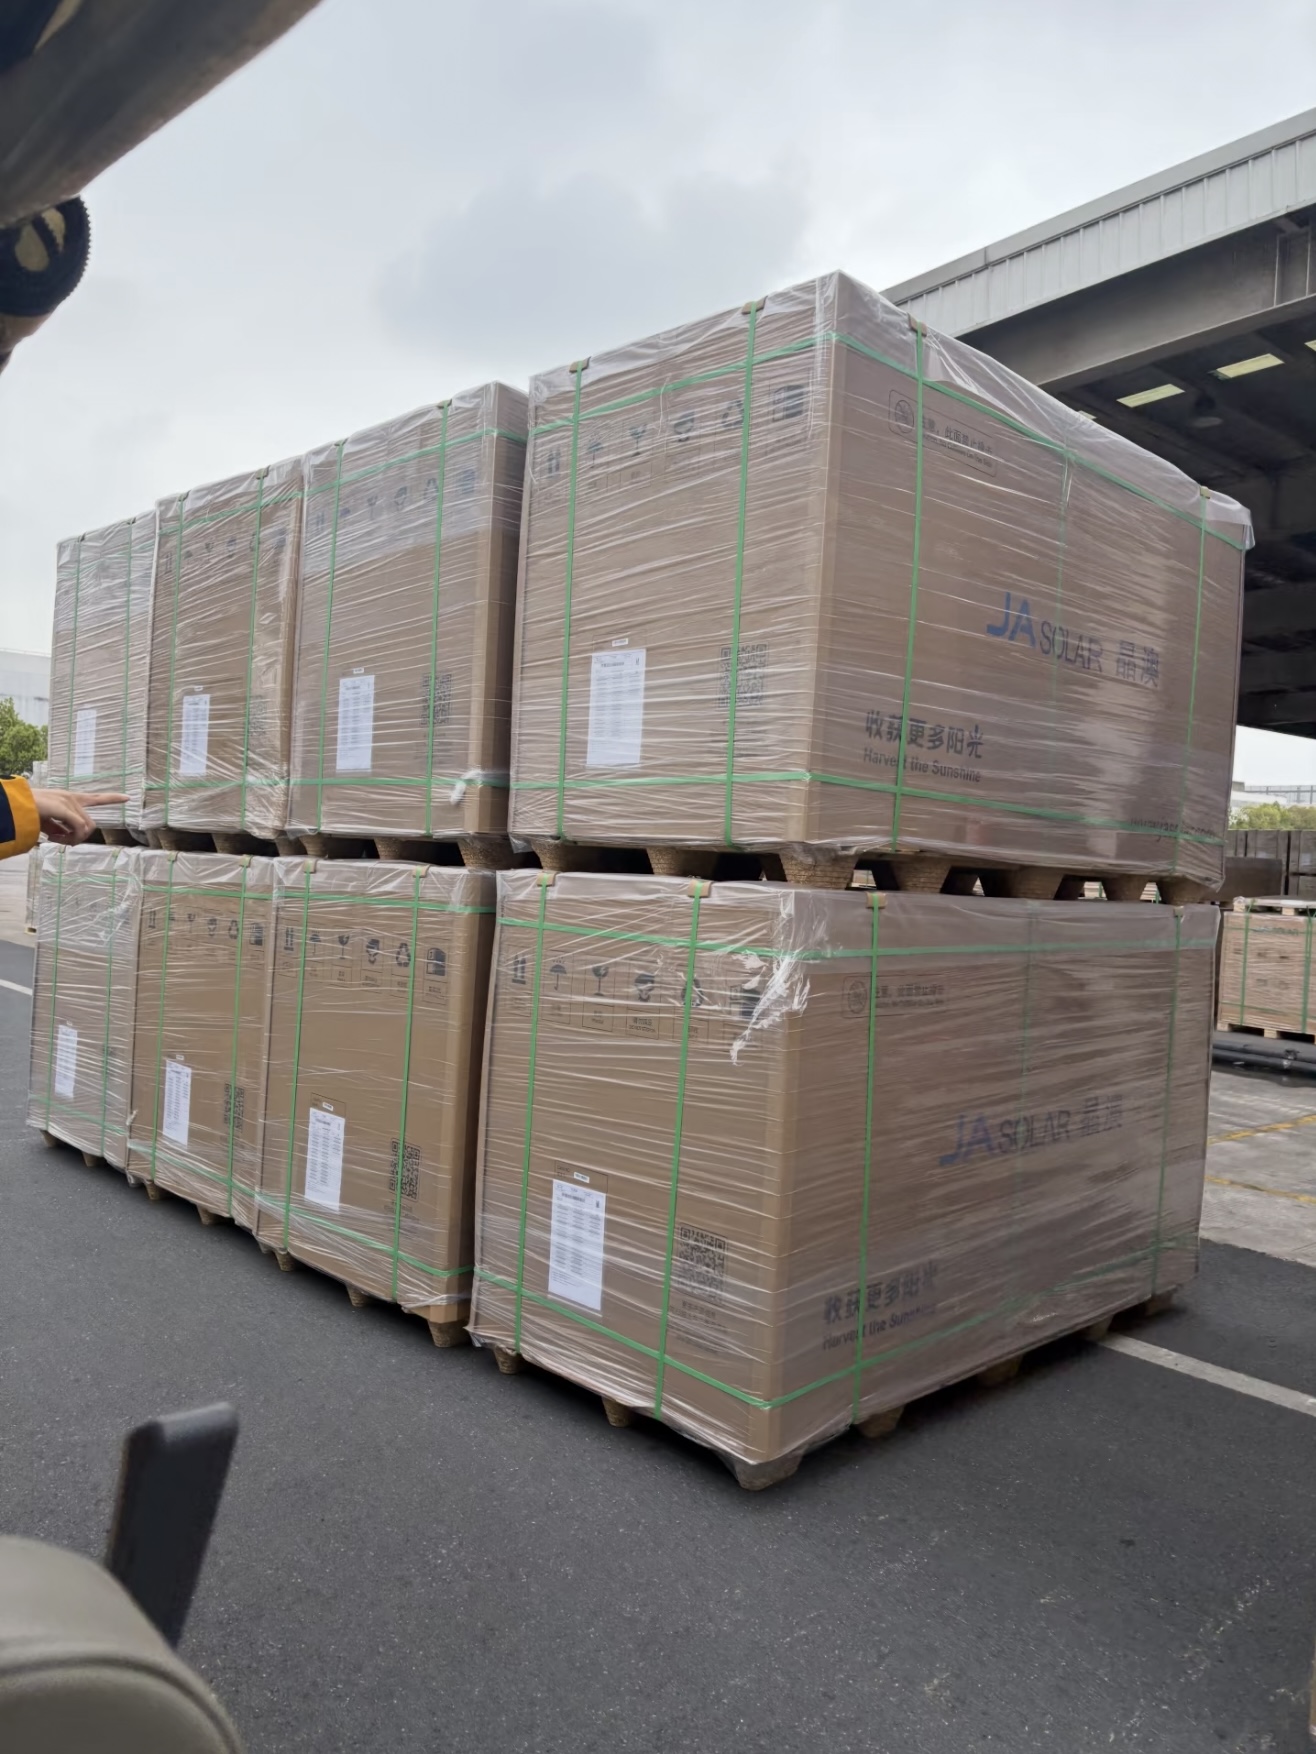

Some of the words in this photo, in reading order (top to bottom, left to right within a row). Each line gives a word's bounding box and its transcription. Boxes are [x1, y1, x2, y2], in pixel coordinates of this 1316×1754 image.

[986, 591, 1036, 648] JA
[1039, 620, 1103, 672] SOLAR
[863, 746, 907, 771] Harvet
[910, 755, 929, 773] the
[931, 759, 982, 783] Sunshine
[938, 1112, 997, 1167] JA
[999, 1110, 1071, 1153] SOLAR
[822, 1323, 866, 1350] Harvet
